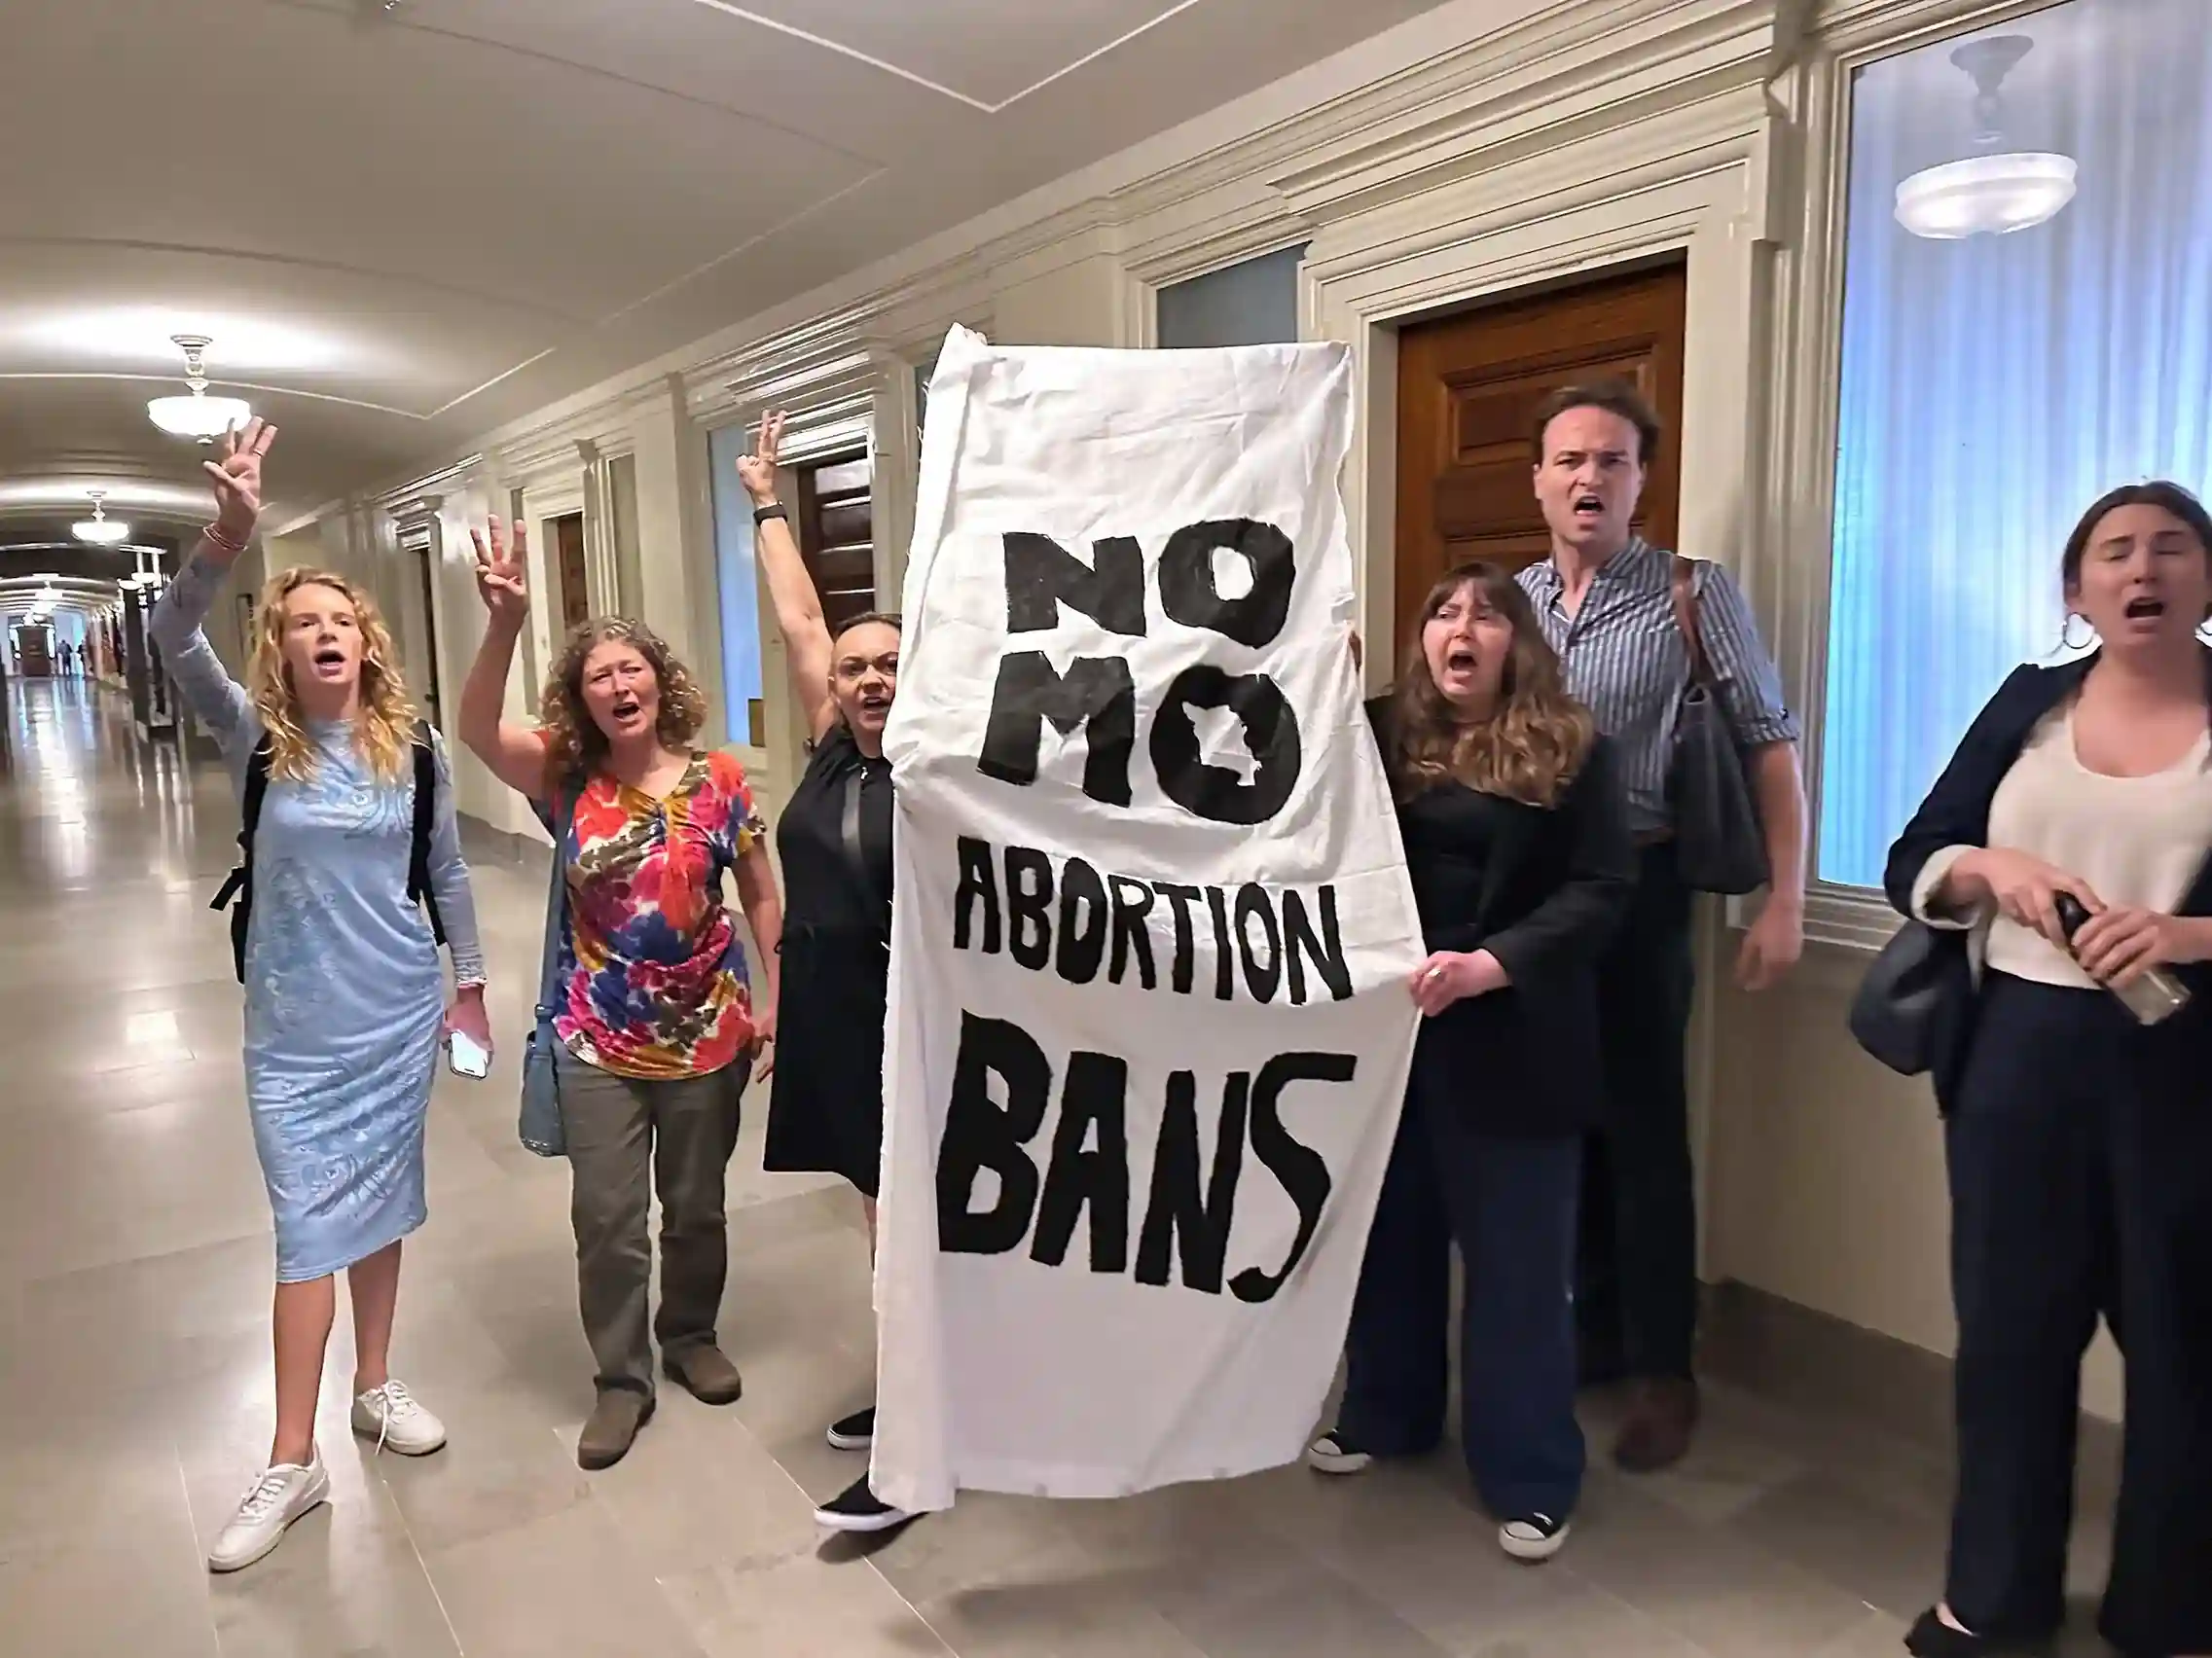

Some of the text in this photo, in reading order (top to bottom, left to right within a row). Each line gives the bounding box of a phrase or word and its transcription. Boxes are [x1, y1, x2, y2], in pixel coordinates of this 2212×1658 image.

[1001, 517, 1295, 650] NO
[976, 649, 1302, 826] MO
[953, 834, 1354, 1006] ABORTION
[936, 1007, 1359, 1304] BANS
